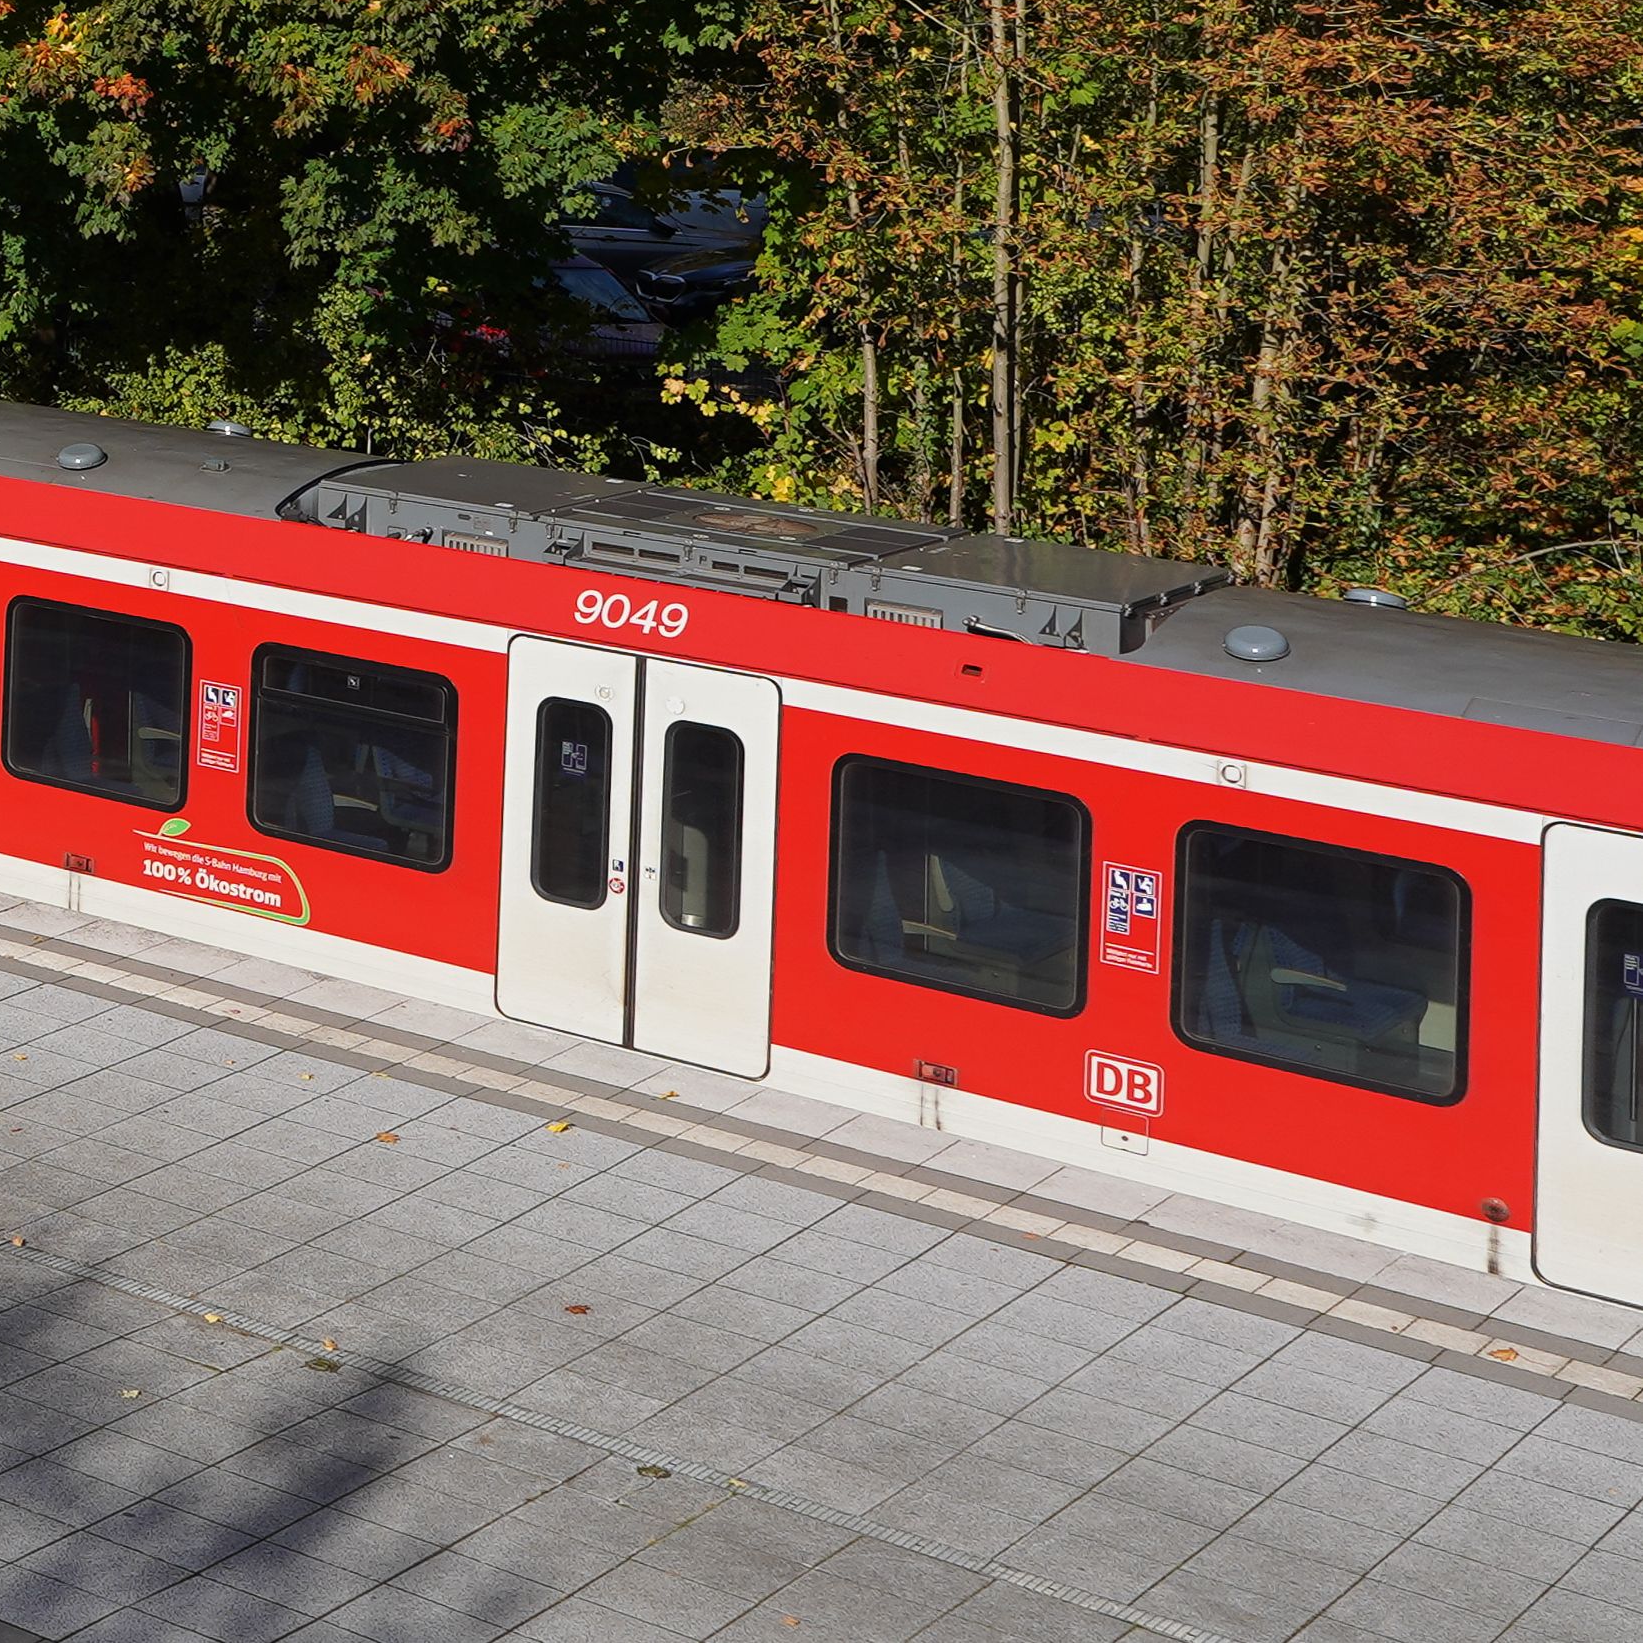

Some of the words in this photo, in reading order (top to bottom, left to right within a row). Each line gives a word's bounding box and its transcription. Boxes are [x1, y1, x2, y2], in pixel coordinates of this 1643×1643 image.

[574, 589, 689, 638] 9049
[158, 845, 191, 861] bewegen
[192, 854, 204, 865] die
[205, 856, 231, 871] S-Bahn
[232, 862, 267, 882] Hamburg
[268, 873, 282, 884] mit
[195, 868, 282, 908] Ökostrom
[1096, 1061, 1152, 1104] DB
